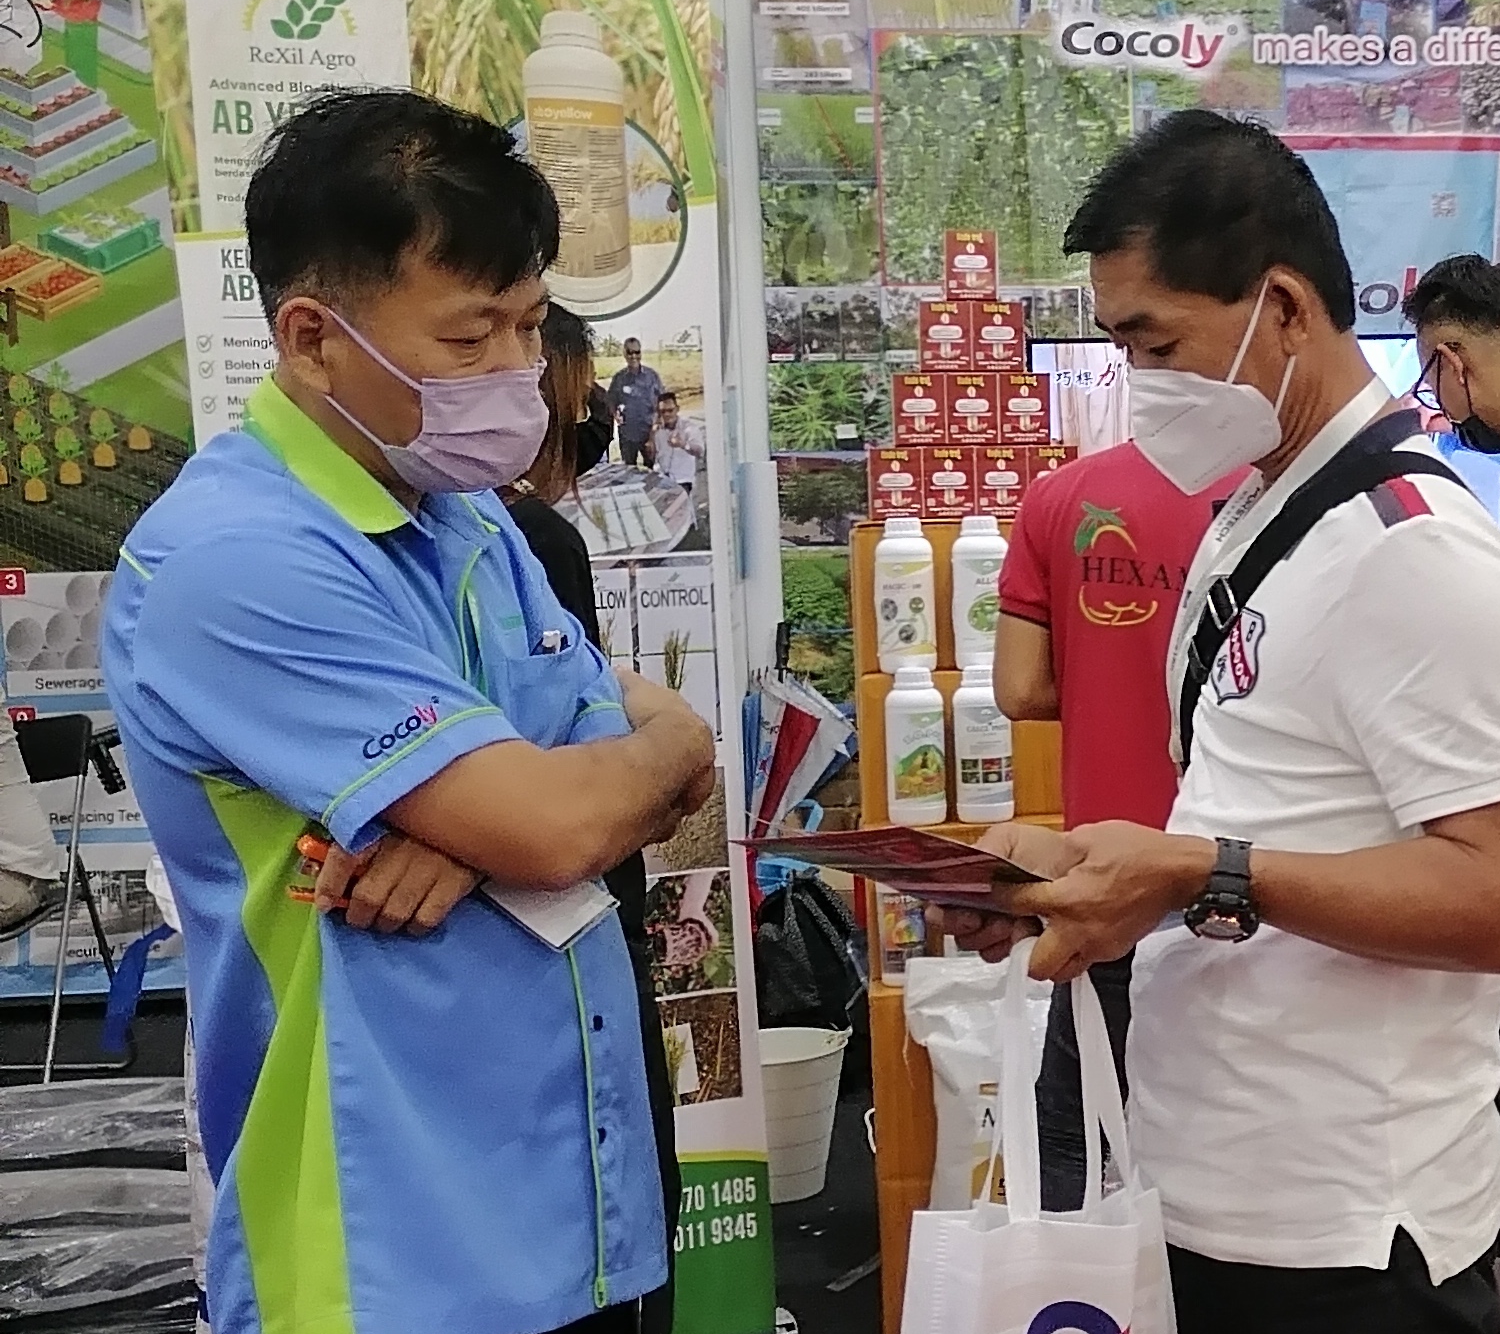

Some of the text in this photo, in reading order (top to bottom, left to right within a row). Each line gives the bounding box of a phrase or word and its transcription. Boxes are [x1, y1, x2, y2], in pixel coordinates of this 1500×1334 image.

[1061, 21, 1224, 69] Cocoly
[1256, 27, 1384, 62] makes
[1393, 38, 1414, 62] a
[249, 47, 356, 70] ReXil Agro
[209, 79, 284, 93] Advanced
[212, 99, 254, 135] AB
[221, 274, 255, 301] AB
[225, 360, 260, 370] Boleh
[5, 574, 18, 590] 3
[641, 588, 708, 608] CONTROL
[35, 677, 105, 691] Sewerage
[362, 703, 437, 759] Cocoly
[117, 809, 141, 823] Tee
[680, 1176, 757, 1213] 70 1485
[711, 1212, 758, 1245] 9345
